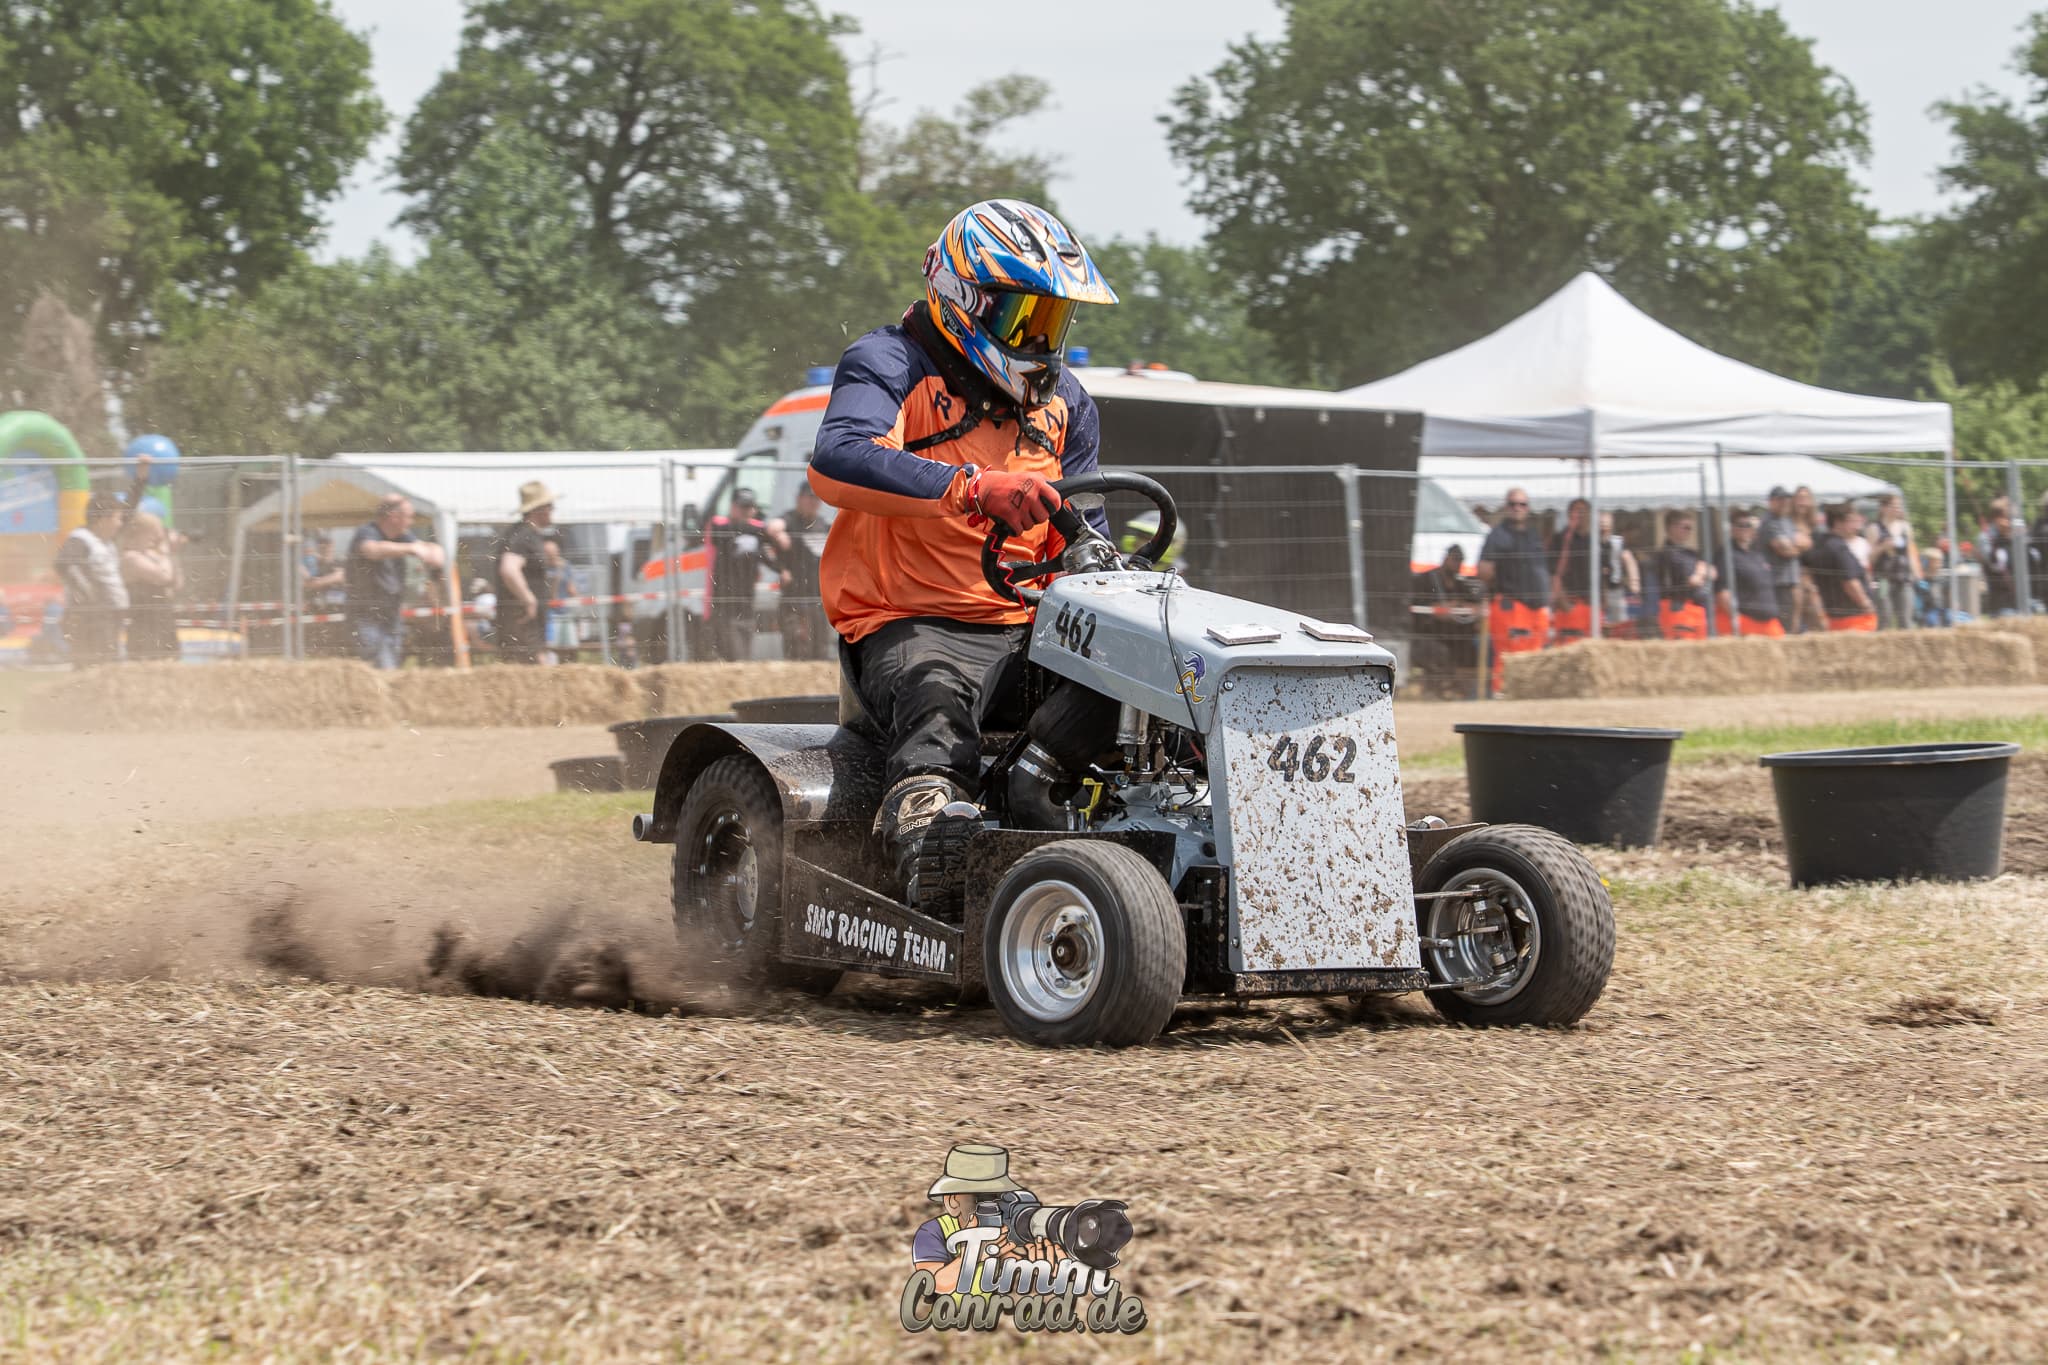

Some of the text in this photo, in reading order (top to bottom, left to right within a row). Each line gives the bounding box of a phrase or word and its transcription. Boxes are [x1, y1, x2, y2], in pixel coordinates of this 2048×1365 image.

[1055, 601, 1097, 659] 462
[1267, 735, 1357, 783] 462
[900, 816, 934, 835] ONE
[804, 903, 947, 972] SMS RACING TEAM
